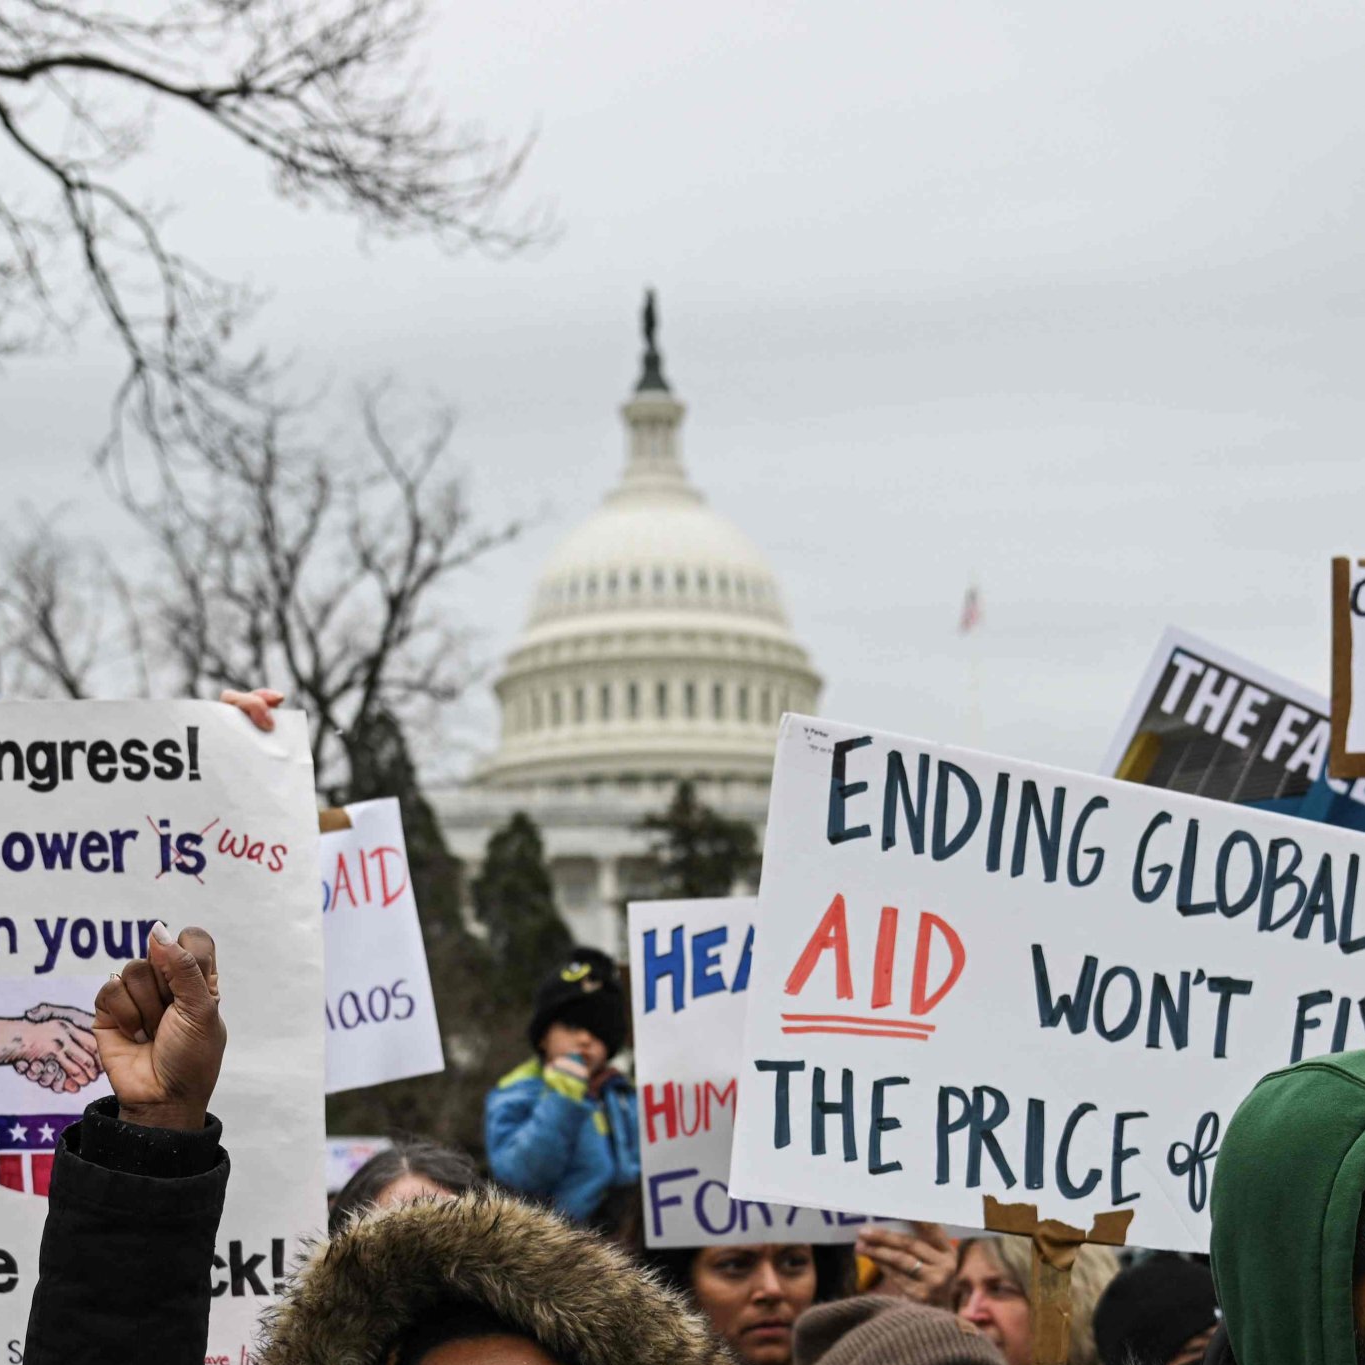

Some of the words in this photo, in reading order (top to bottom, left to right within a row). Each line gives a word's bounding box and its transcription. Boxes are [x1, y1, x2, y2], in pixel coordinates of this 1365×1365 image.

[1158, 649, 1270, 748] THE
[159, 819, 206, 875] is
[218, 826, 288, 873] was
[827, 736, 1108, 886] ENDING
[323, 846, 408, 912] AID
[35, 916, 167, 973] your
[784, 893, 966, 1015] AID
[1032, 944, 1253, 1058] WON'T
[754, 1060, 910, 1174] THE
[936, 1085, 1149, 1206] PRICE
[1167, 1110, 1218, 1213] of
